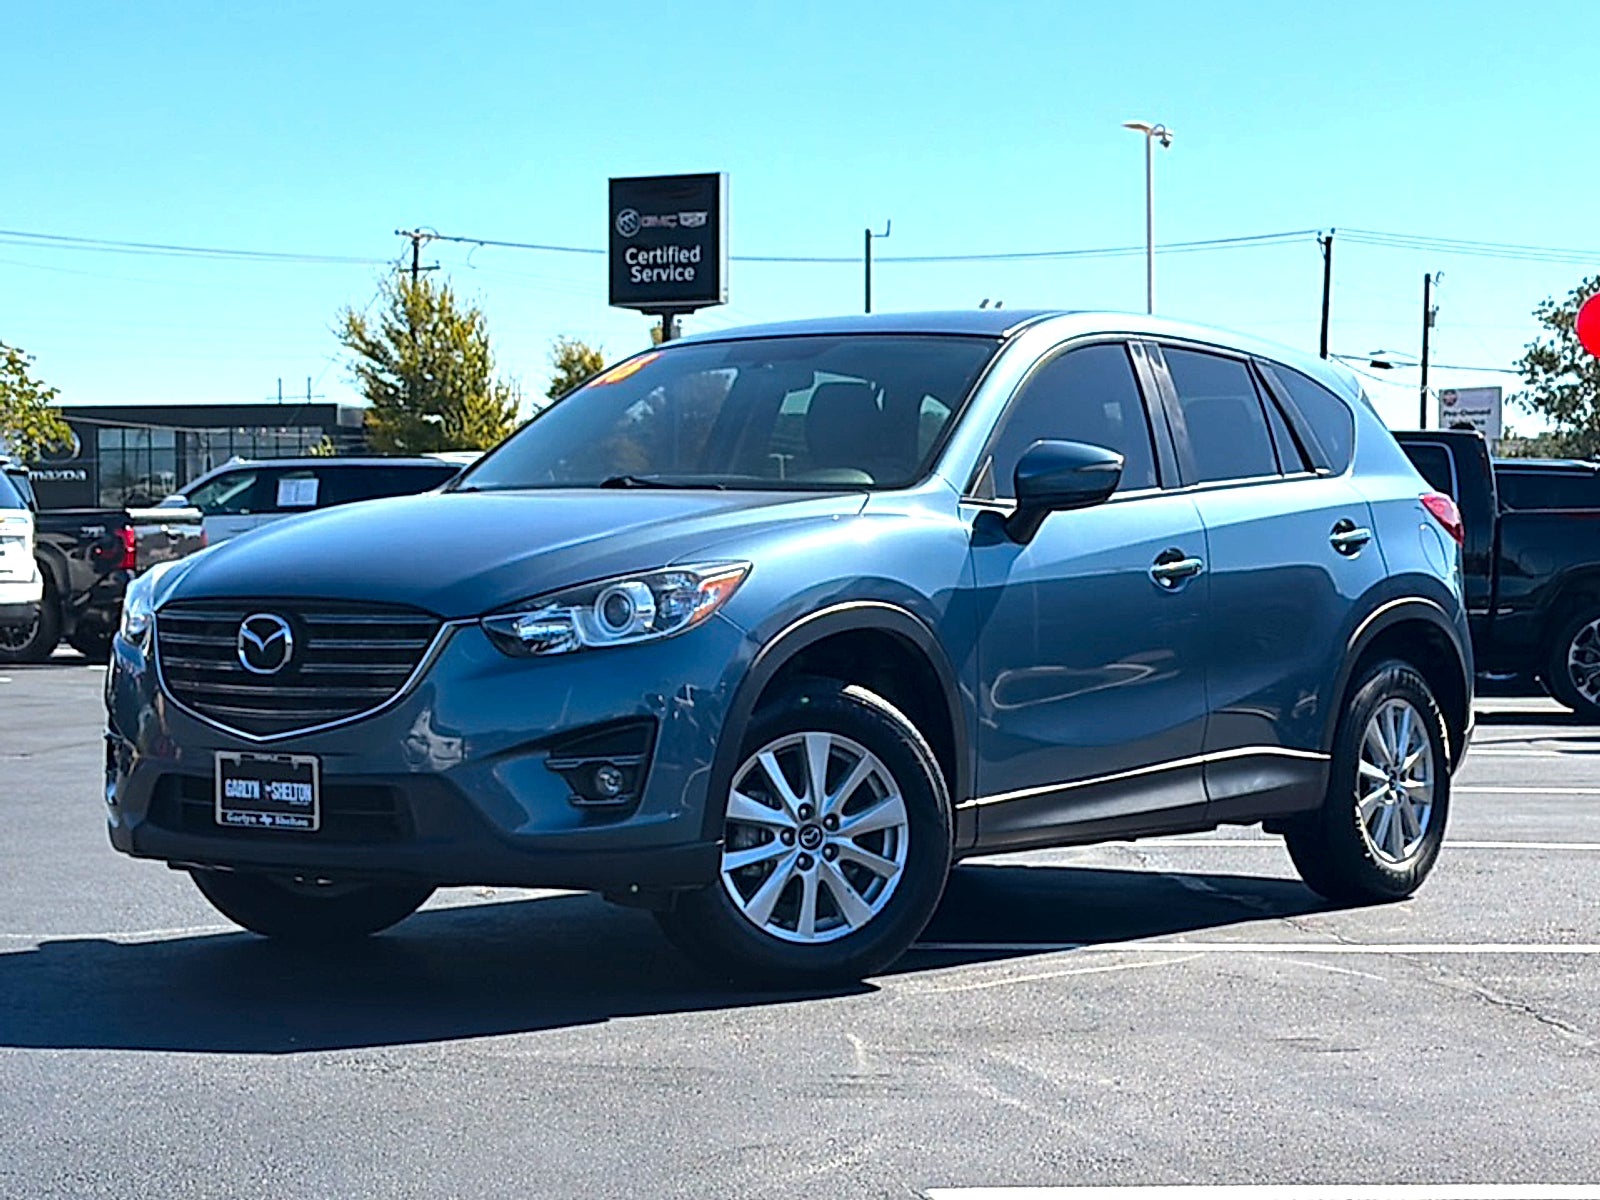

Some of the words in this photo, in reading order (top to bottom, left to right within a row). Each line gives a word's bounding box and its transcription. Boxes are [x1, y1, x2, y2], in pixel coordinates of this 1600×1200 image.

[624, 245, 701, 265] Certified
[630, 264, 695, 283] Service
[28, 469, 87, 481] mazda
